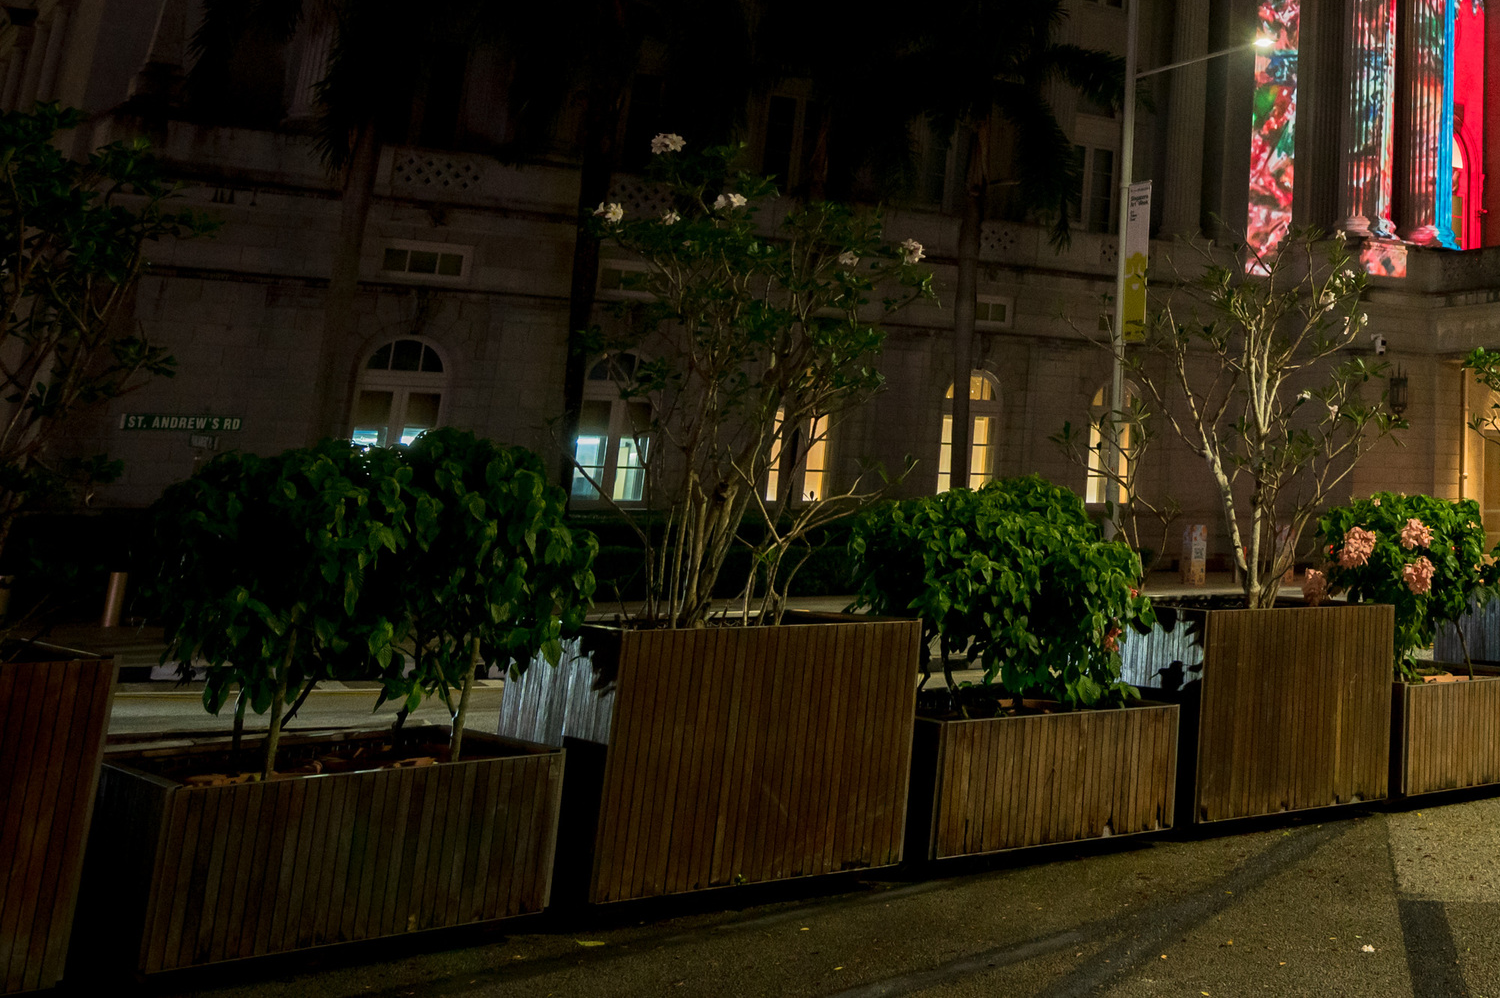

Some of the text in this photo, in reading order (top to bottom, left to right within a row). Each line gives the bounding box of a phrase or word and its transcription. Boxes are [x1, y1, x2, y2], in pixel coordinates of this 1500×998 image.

[127, 416, 241, 430] ST. ANDREW'S RD
